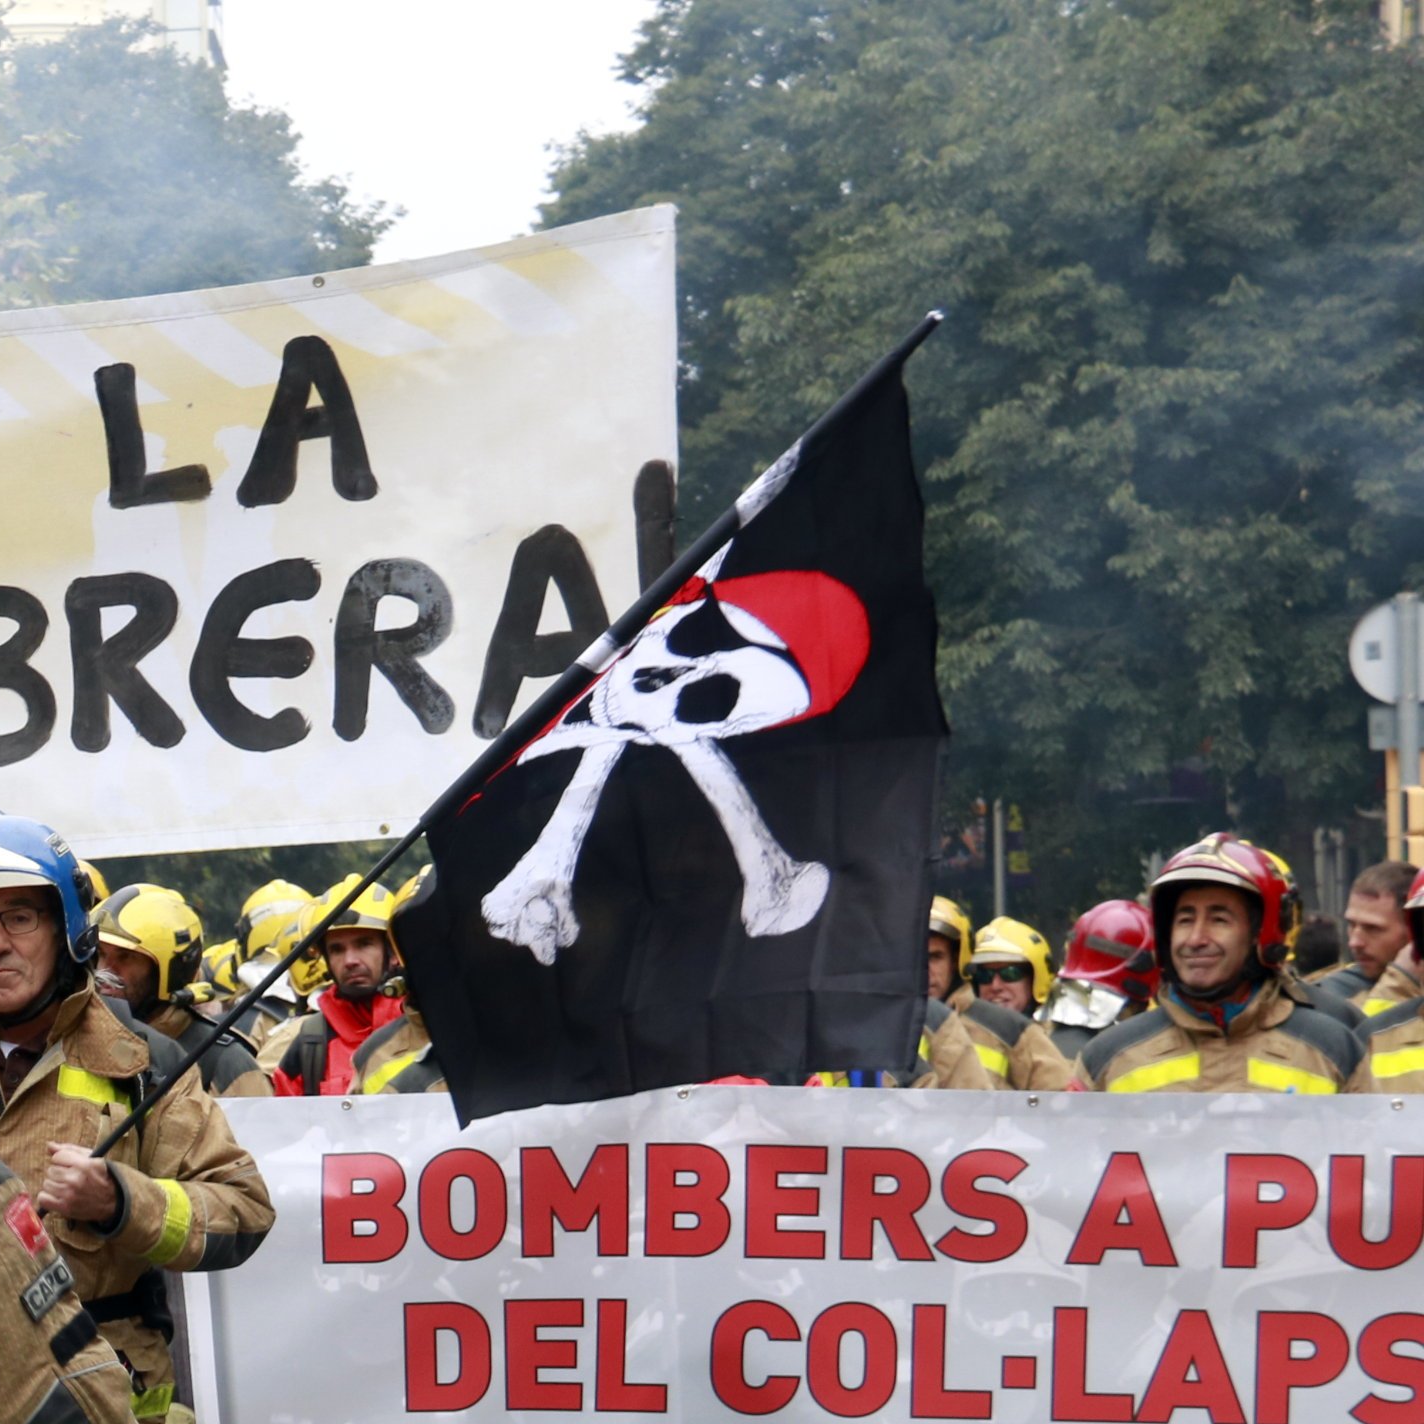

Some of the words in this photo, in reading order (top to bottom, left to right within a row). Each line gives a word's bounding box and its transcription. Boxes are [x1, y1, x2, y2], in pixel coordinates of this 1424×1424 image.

[94, 335, 379, 508] LA
[321, 1142, 1029, 1263] BOMBERS
[1065, 1151, 1178, 1267] A
[403, 1299, 668, 1412] DEL
